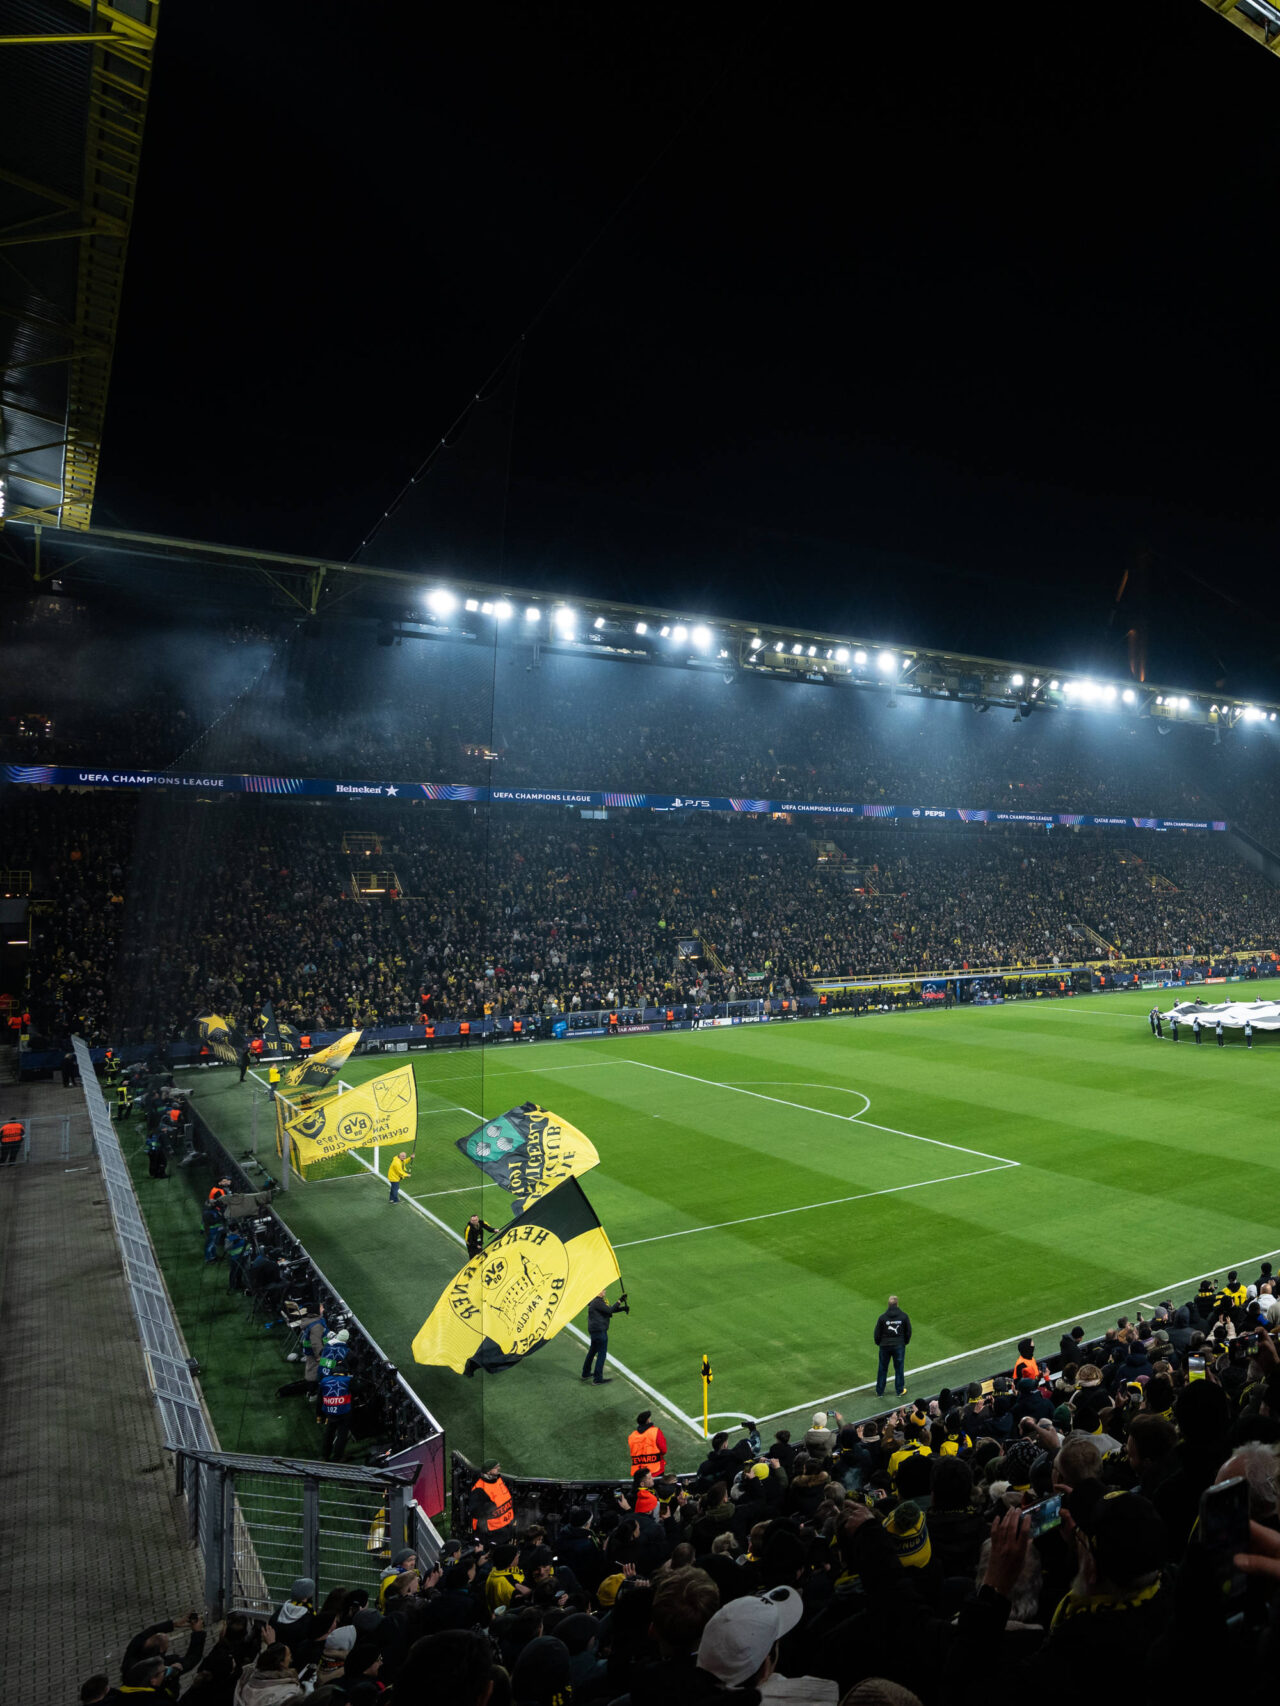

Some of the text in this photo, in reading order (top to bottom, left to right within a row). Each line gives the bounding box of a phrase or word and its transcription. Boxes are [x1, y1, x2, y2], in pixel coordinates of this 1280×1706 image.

[79, 773, 225, 787] UEFA CHAMPIONS LEAGUE
[335, 784, 382, 794] Heineken
[493, 791, 592, 803] UEFA CHAMPIONS LEAGUE
[684, 799, 710, 807] PS5
[924, 809, 946, 817] PEPSI
[322, 1396, 345, 1405] PHOTO
